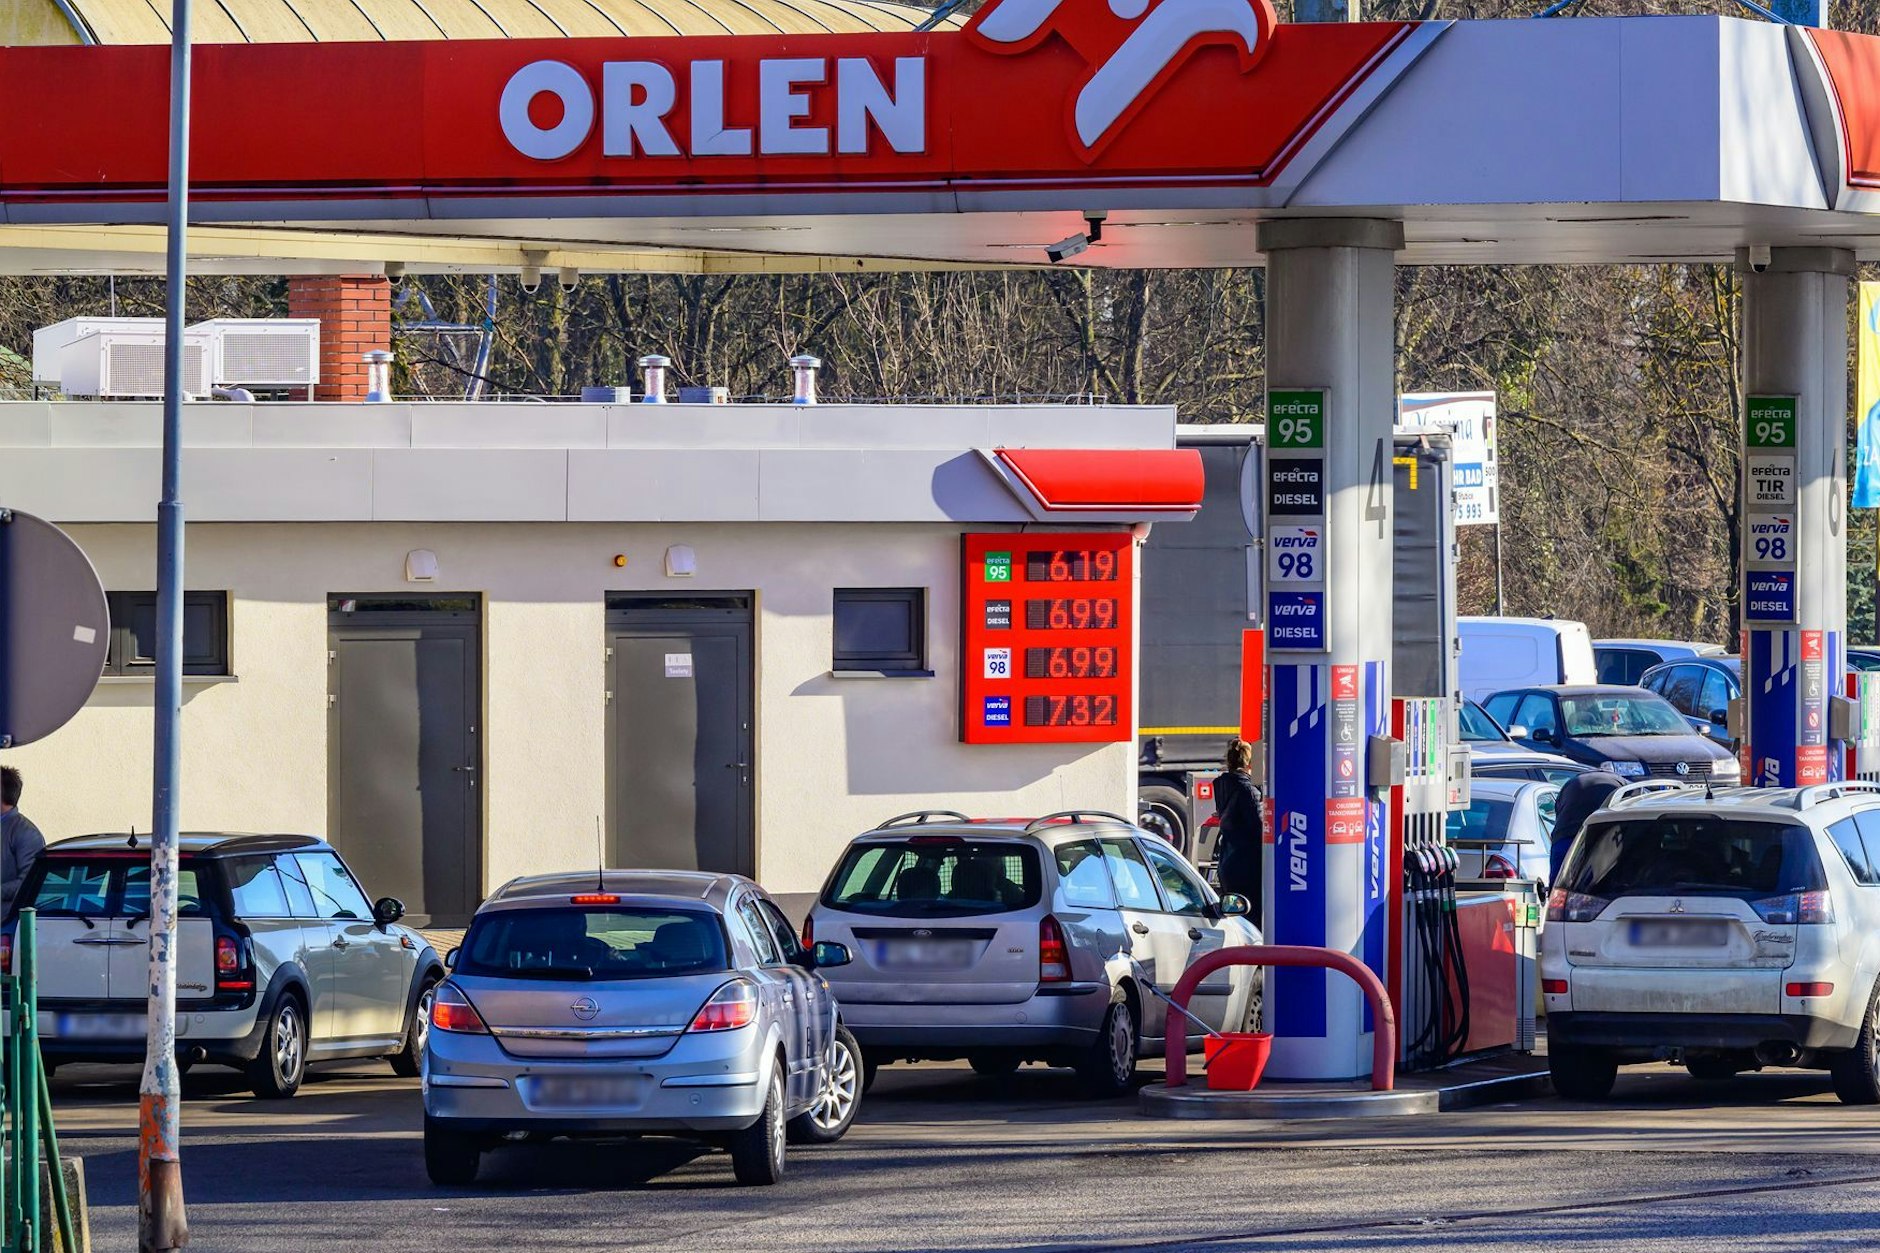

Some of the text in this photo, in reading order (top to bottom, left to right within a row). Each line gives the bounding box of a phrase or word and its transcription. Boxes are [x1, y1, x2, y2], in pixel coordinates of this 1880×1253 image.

[499, 57, 926, 160] ORLEN
[1278, 418, 1312, 443] 95
[1755, 422, 1785, 444] 95
[1365, 438, 1386, 539] 4
[1756, 479, 1784, 492] TIR
[1273, 494, 1318, 505] DIESEL
[1466, 503, 1481, 518] 993
[1751, 524, 1790, 534] verva
[1274, 537, 1318, 548] verva
[1755, 537, 1786, 560] 98
[989, 566, 1007, 579] 95
[1050, 551, 1113, 580] 6.19
[1278, 552, 1313, 578] 98
[1751, 582, 1788, 592] verva
[1050, 599, 1113, 629] 6.99
[1274, 605, 1317, 616] verva
[1750, 601, 1789, 611] DIESEL
[1273, 627, 1318, 638] DIESEL
[989, 661, 1006, 674] 98
[1050, 648, 1113, 678] 6.99
[1049, 696, 1112, 725] 7.32
[1290, 811, 1308, 891] verva
